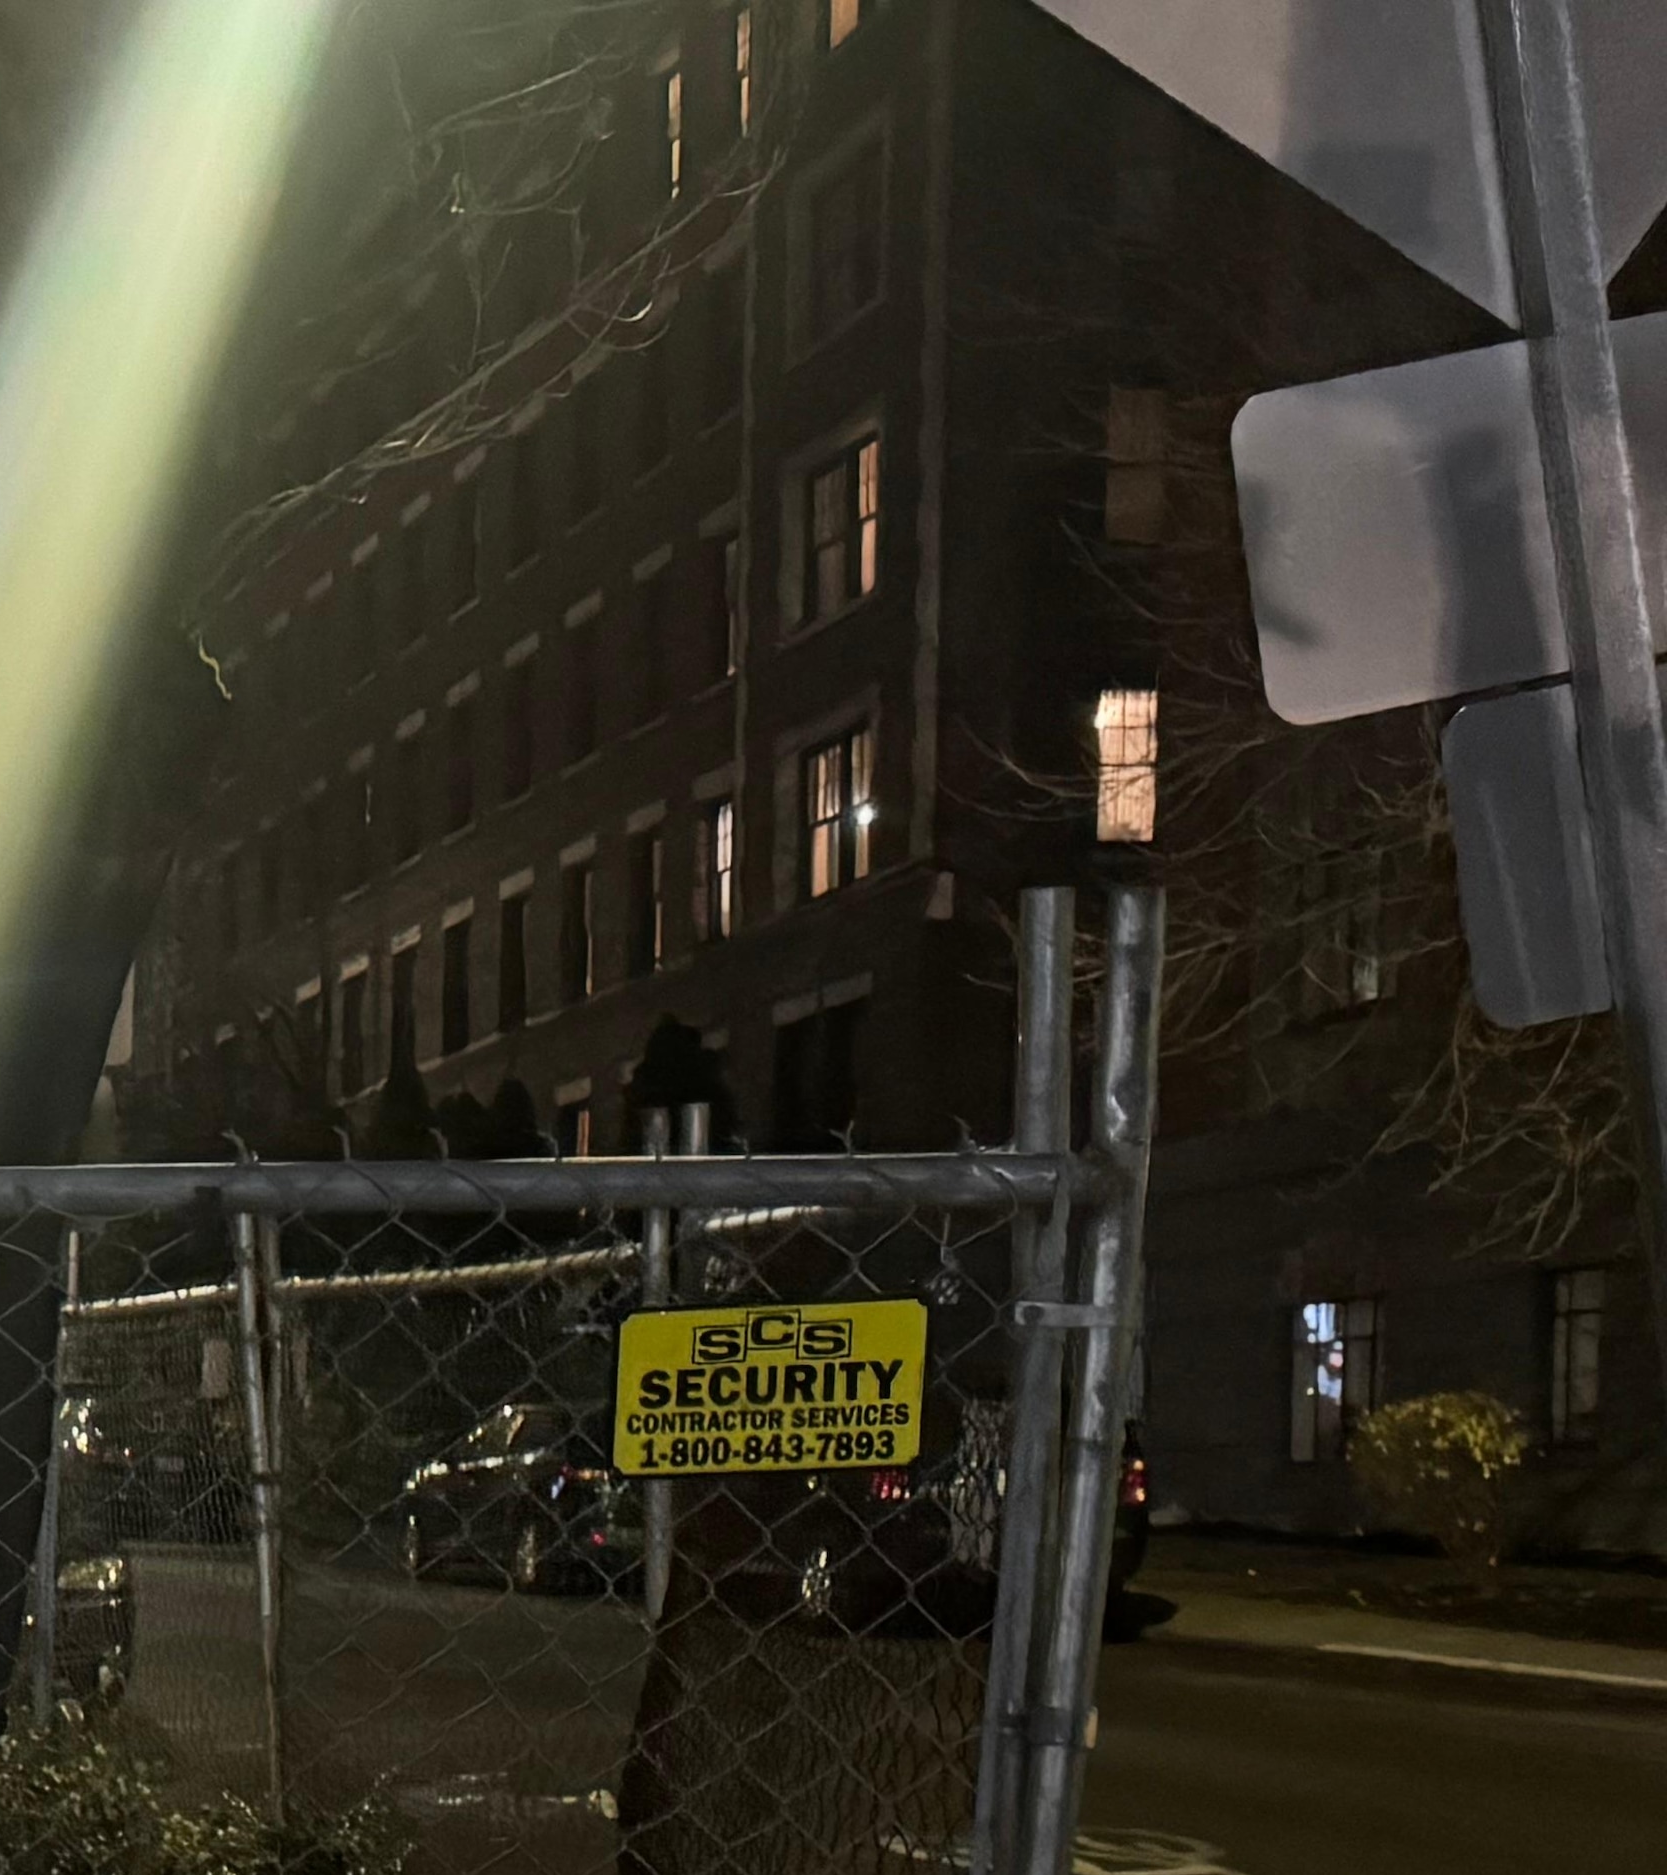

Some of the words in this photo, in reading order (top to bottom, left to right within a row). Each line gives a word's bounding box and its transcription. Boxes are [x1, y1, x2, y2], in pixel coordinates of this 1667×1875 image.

[697, 1313, 848, 1361] SCS
[637, 1359, 904, 1410] SECURITY
[626, 1408, 783, 1436] CONTRACTOR
[790, 1402, 910, 1429] SERVICES
[639, 1429, 896, 1469] 1-800-843-7893
